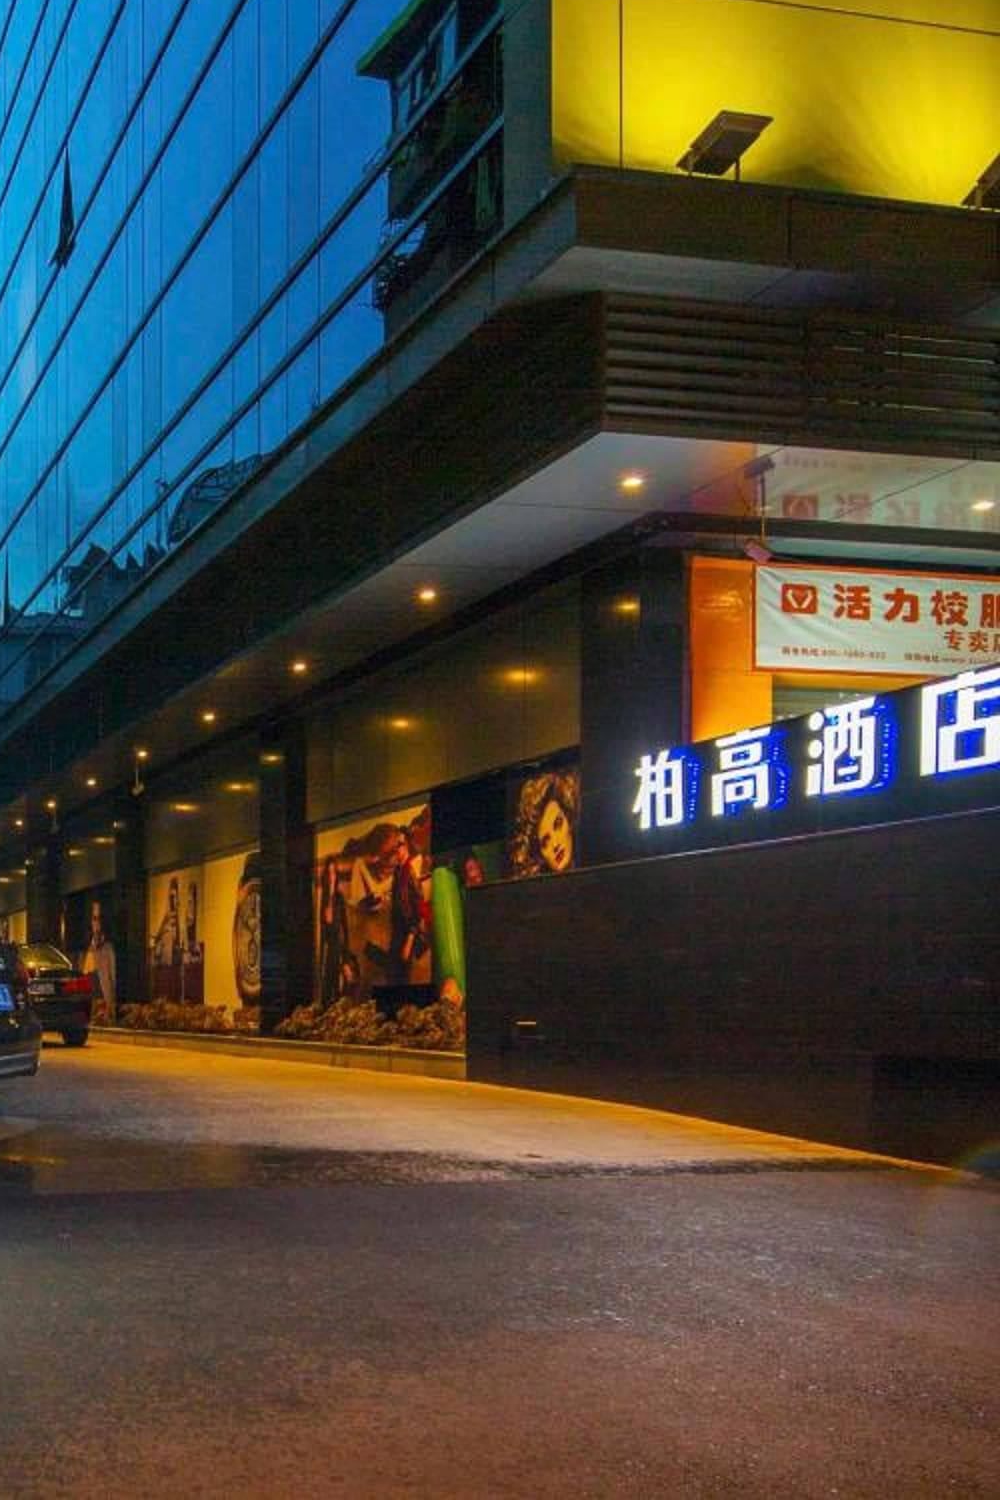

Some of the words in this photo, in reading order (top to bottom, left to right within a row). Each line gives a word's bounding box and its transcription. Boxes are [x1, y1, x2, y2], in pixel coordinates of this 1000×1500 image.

[944, 629, 1000, 653] 专卖
[631, 667, 1000, 829] 柏高酒店
